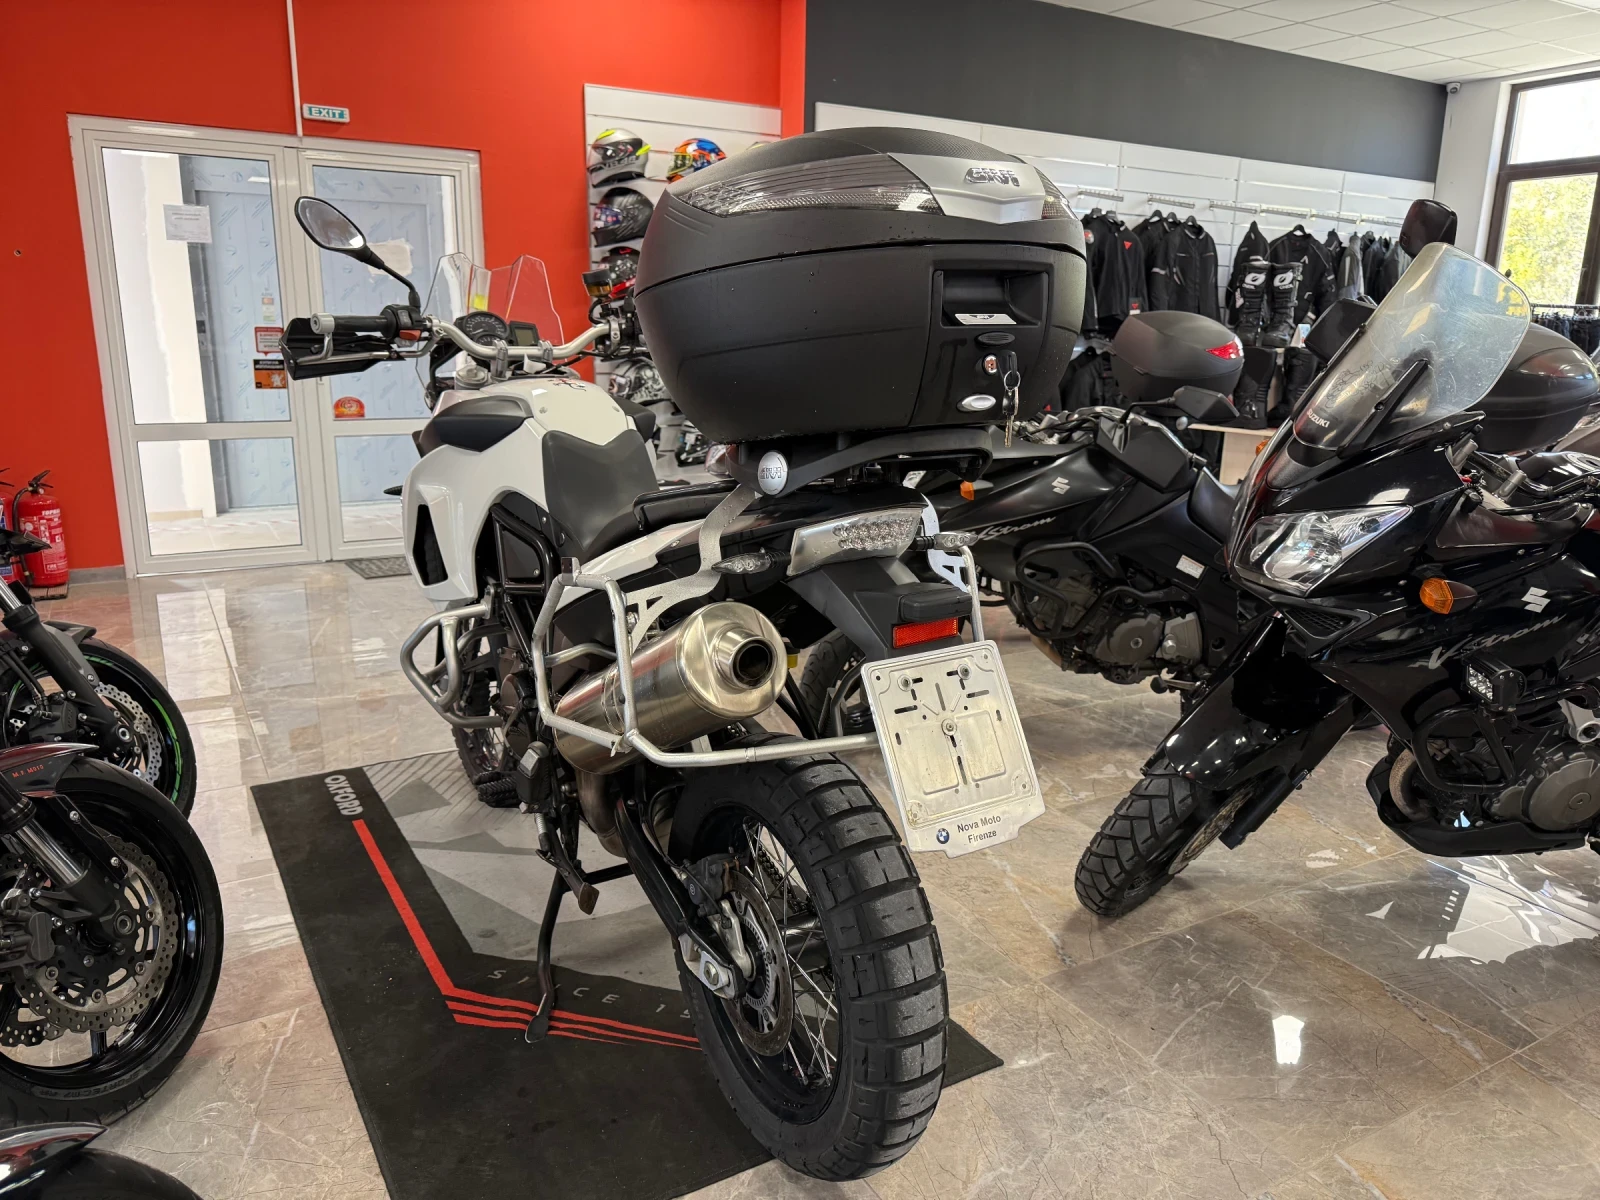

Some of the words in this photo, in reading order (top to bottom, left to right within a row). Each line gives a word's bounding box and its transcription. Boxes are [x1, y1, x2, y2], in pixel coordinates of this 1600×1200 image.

[311, 107, 342, 118] EXIT
[965, 167, 1021, 187] GIVI
[1306, 408, 1330, 428] SUZUKI
[324, 774, 363, 816] OXFORD
[957, 821, 979, 833] Nova
[980, 815, 1001, 827] Moto
[967, 830, 997, 844] Firenze
[488, 969, 620, 1004] SICE
